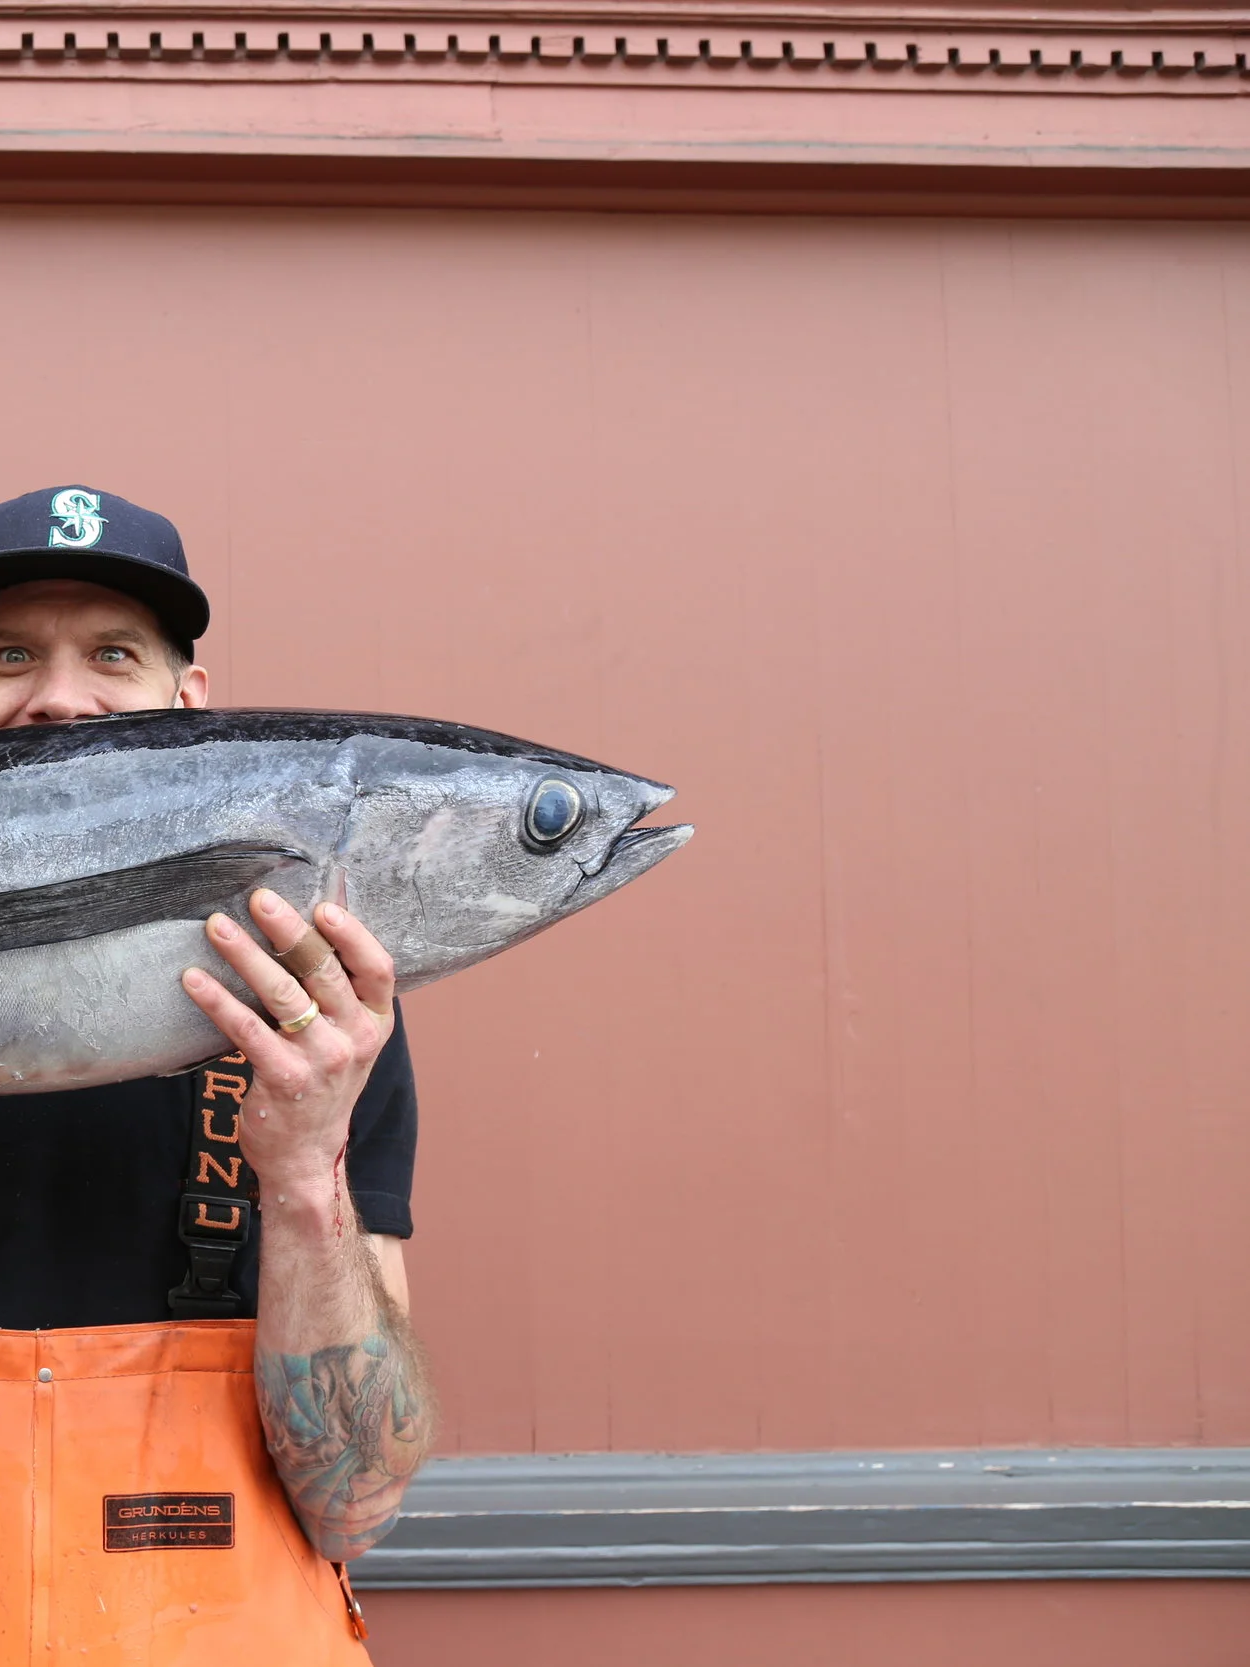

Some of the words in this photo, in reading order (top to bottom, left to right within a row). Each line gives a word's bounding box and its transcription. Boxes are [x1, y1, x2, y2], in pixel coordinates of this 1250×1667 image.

[45, 489, 105, 548] S
[118, 1502, 221, 1518] GRUNDÉNS
[132, 1530, 207, 1541] HERKULES
